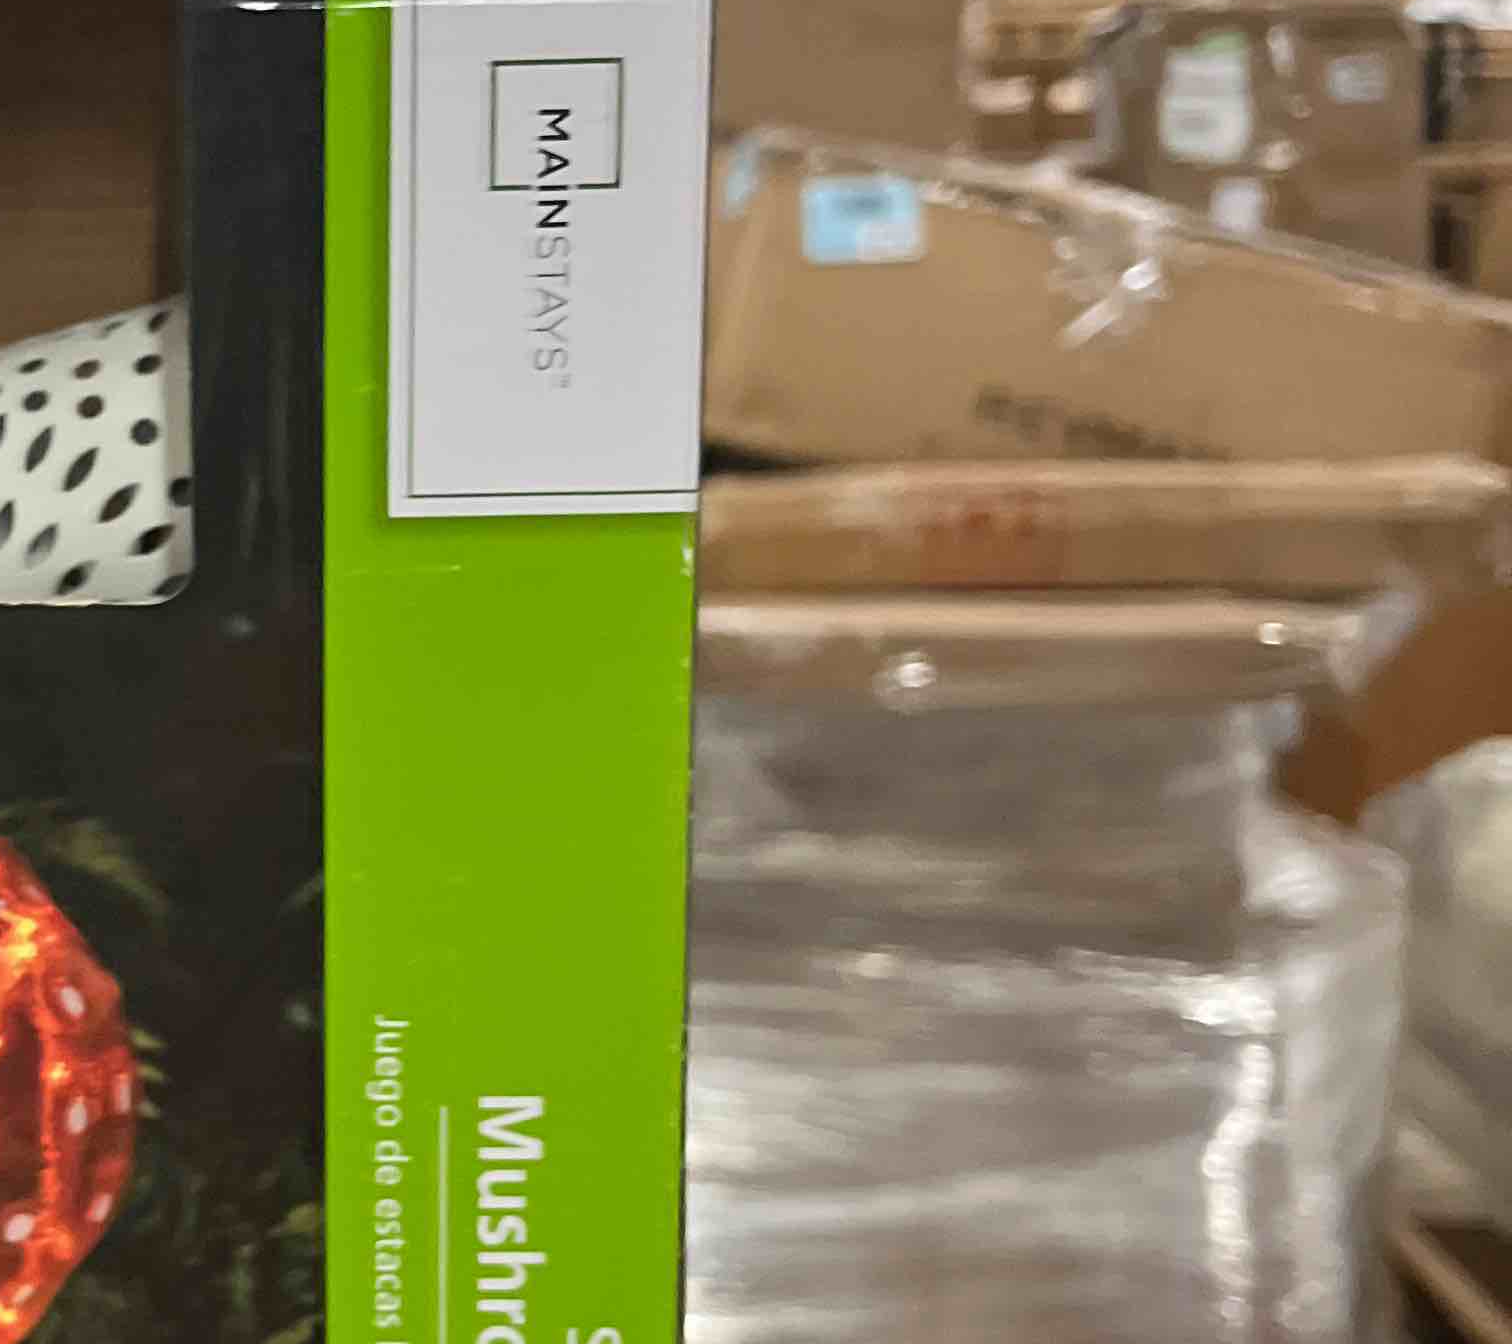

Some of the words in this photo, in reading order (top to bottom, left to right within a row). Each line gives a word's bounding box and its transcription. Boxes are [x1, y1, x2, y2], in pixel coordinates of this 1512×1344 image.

[366, 1015, 408, 1126] Juego
[375, 1140, 409, 1185] de
[376, 1199, 405, 1328] estacas
